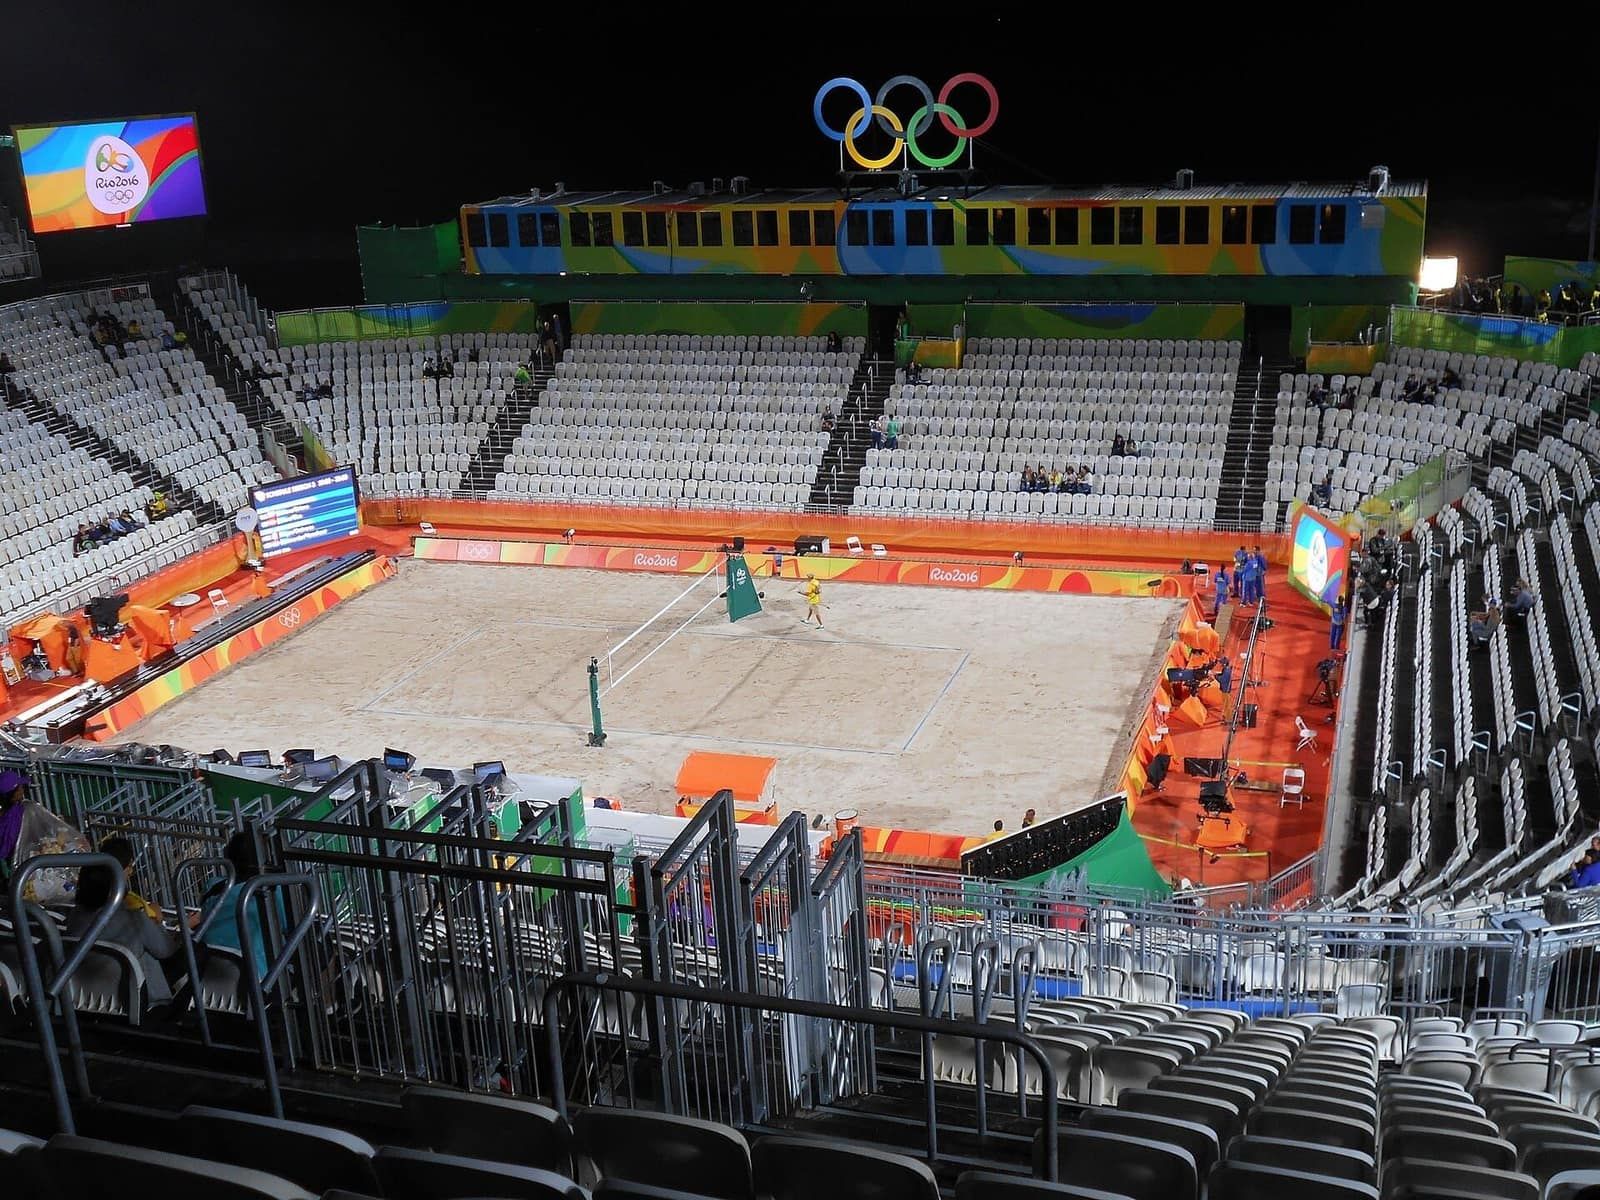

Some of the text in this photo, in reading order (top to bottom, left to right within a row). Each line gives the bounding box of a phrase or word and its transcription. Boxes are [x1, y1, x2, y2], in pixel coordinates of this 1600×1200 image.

[96, 174, 139, 189] Rio2016
[634, 553, 678, 567] Rio2016
[930, 567, 978, 583] Rio2016
